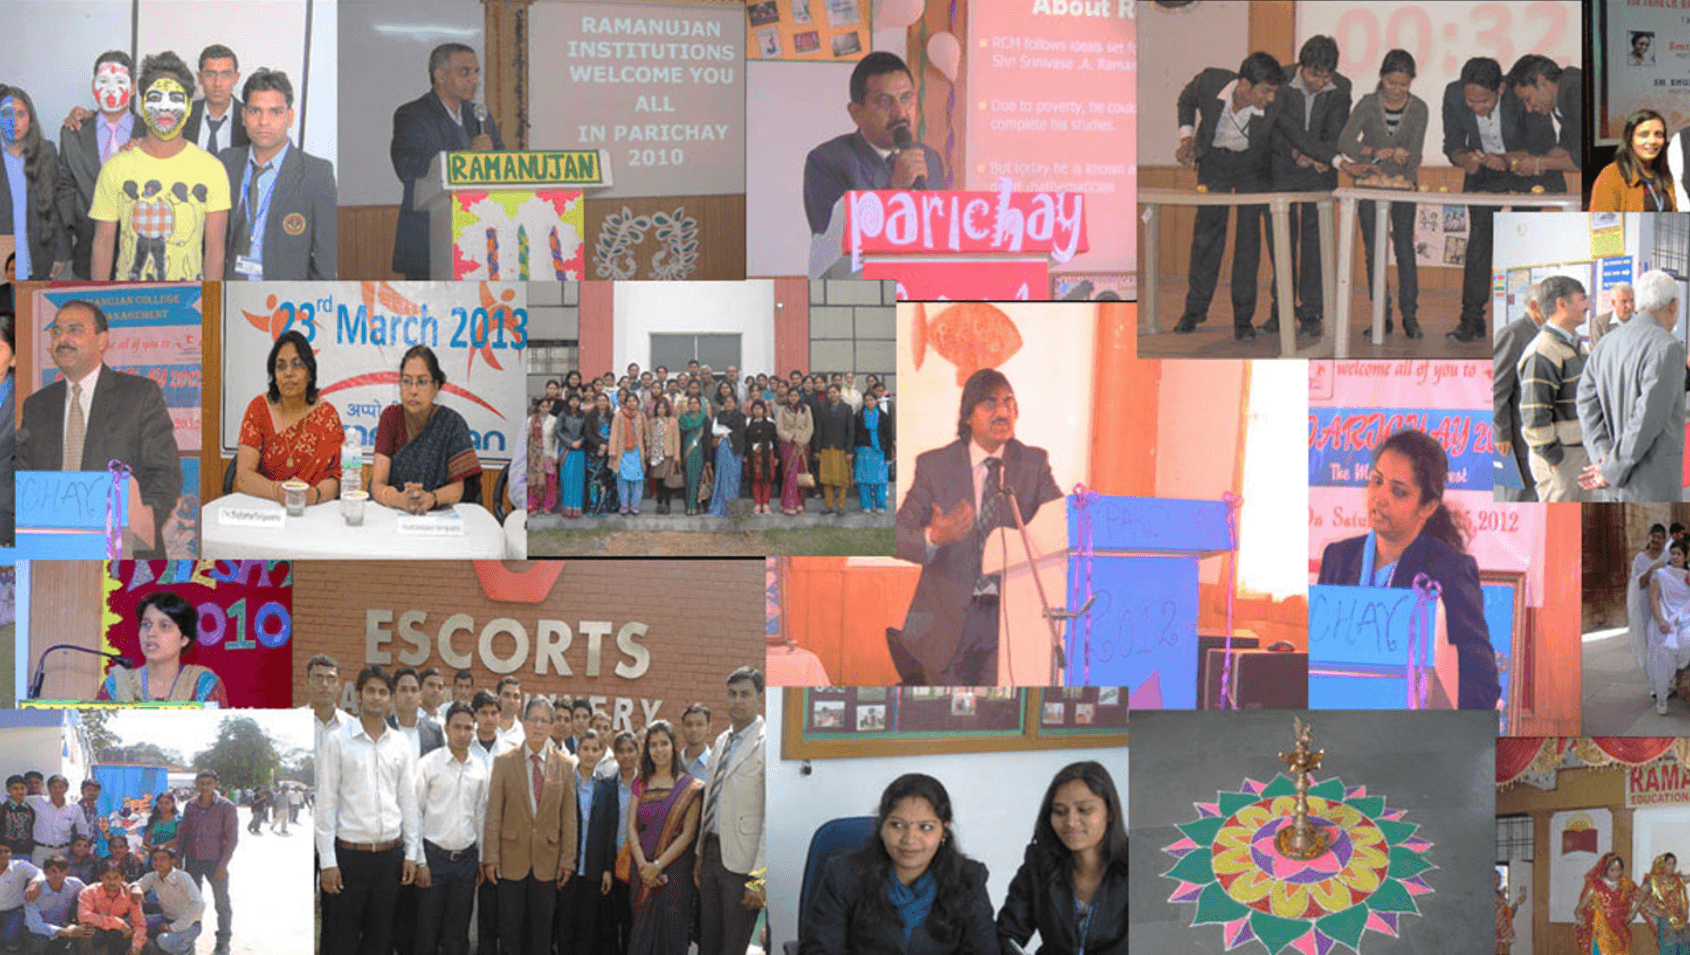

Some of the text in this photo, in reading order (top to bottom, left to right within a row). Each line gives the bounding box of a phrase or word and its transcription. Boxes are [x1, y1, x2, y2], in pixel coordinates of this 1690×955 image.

[1032, 0, 1110, 17] About
[582, 17, 721, 37] RAMANUJAN
[567, 41, 735, 61] INSTITUTIONS
[1336, 2, 1572, 77] 00:32
[569, 66, 734, 84] WELCOME YOU
[634, 95, 676, 113] ALL
[577, 124, 729, 143] IN PARICHAY
[451, 152, 595, 182] RAMANUJAN
[628, 149, 684, 167] 2010
[850, 177, 1085, 273] parichay
[336, 303, 438, 347] March
[449, 306, 528, 350] 2013
[1337, 360, 1477, 386] welcome all of you to
[197, 597, 292, 650] 010
[365, 608, 651, 680] ESCORTS
